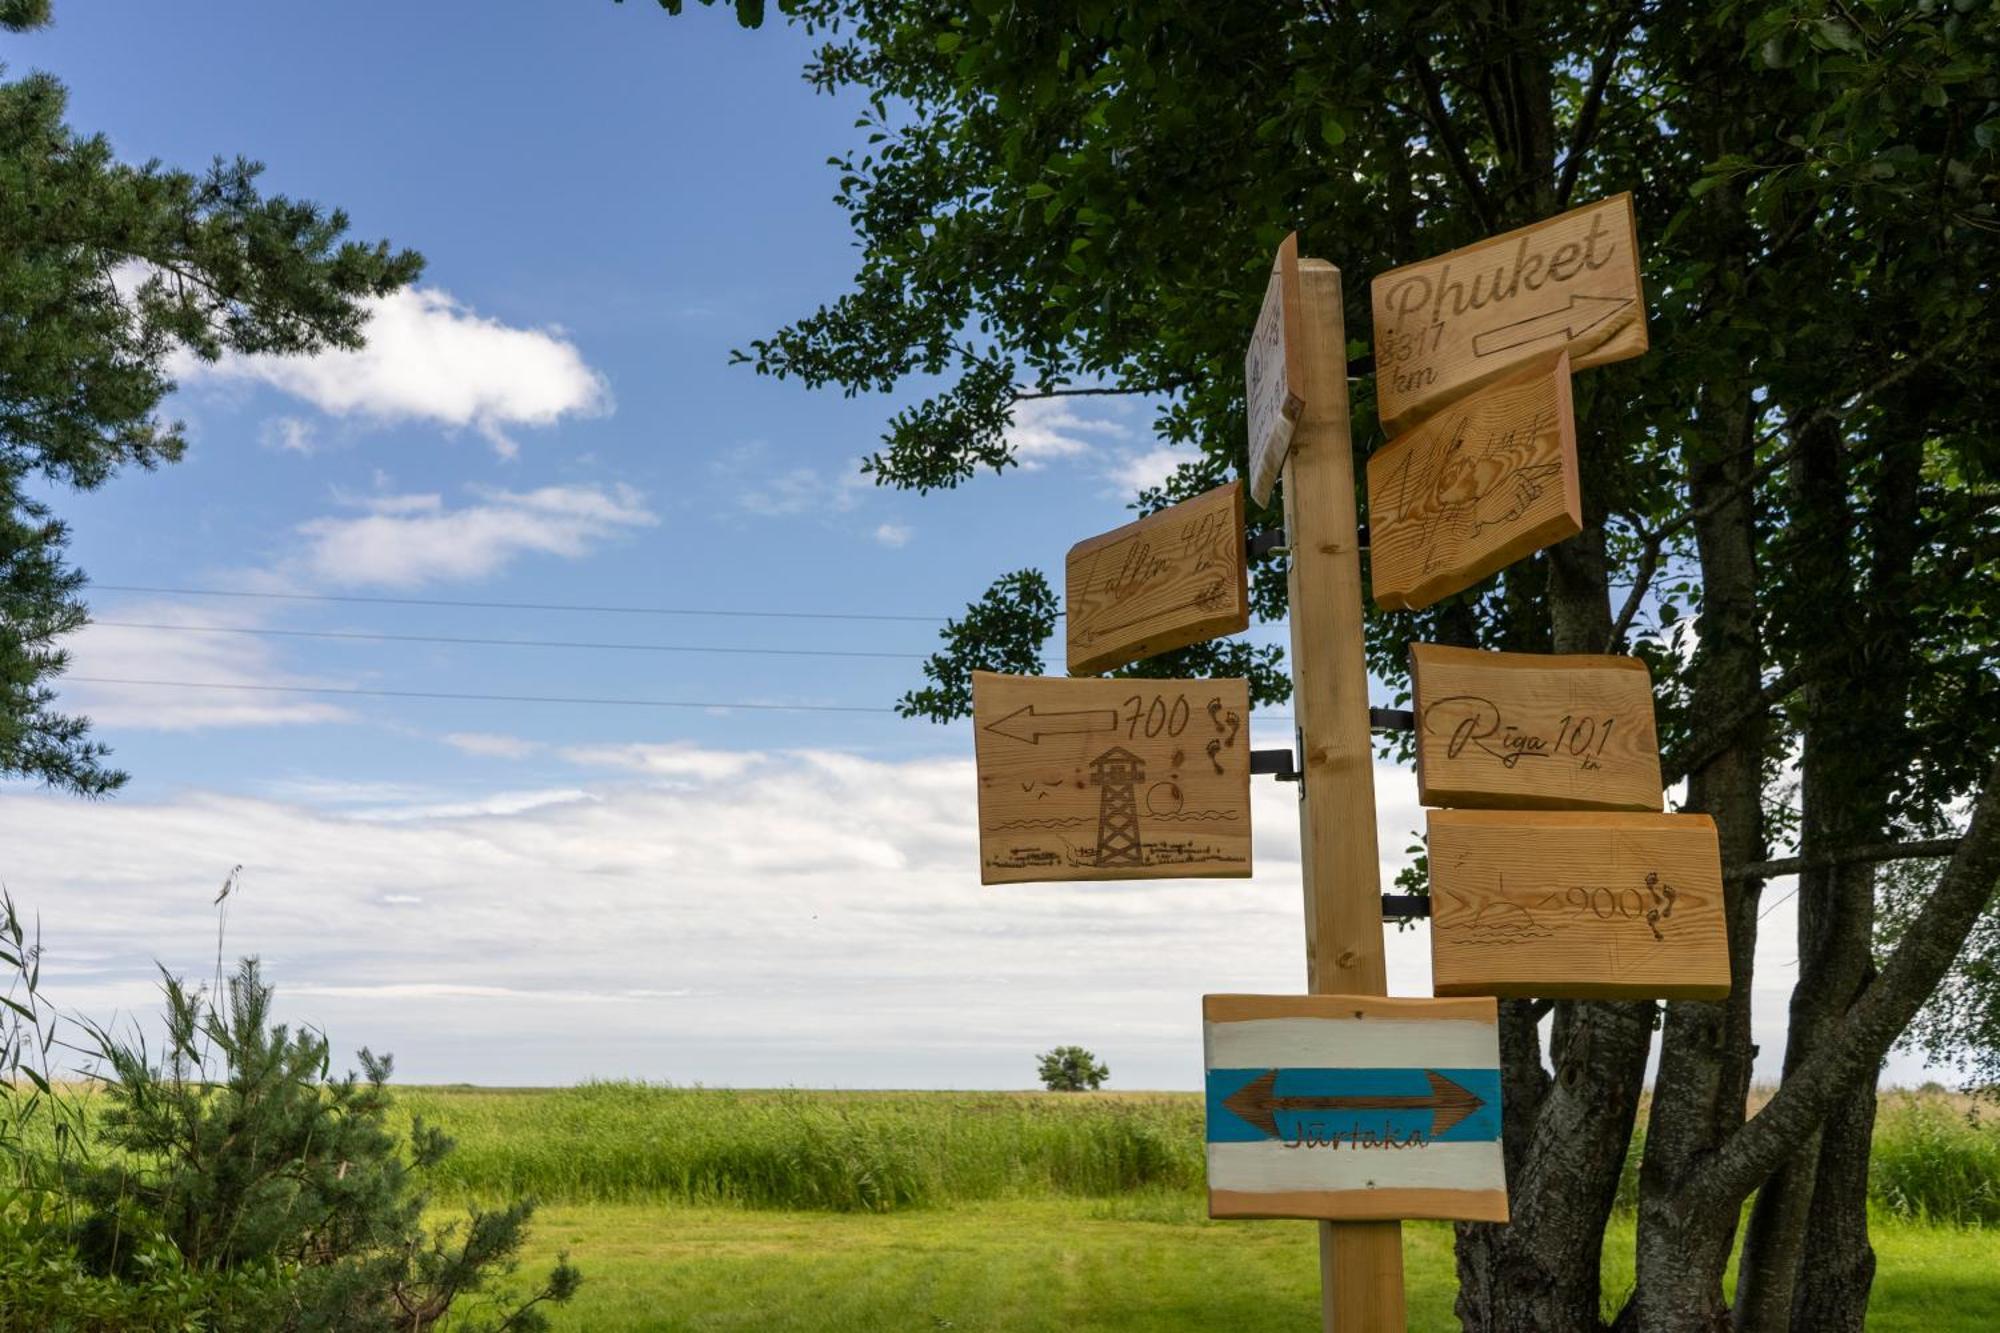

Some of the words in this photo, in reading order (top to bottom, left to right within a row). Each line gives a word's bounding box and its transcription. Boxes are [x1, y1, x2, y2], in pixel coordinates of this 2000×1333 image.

[1384, 212, 1615, 326] Phuket
[1392, 366, 1438, 394] km
[1123, 694, 1190, 740] 700
[1424, 695, 1549, 769] Rīga
[1554, 714, 1614, 757] 101
[1567, 886, 1643, 920] 900
[1283, 1119, 1430, 1151] Jūrtaka
